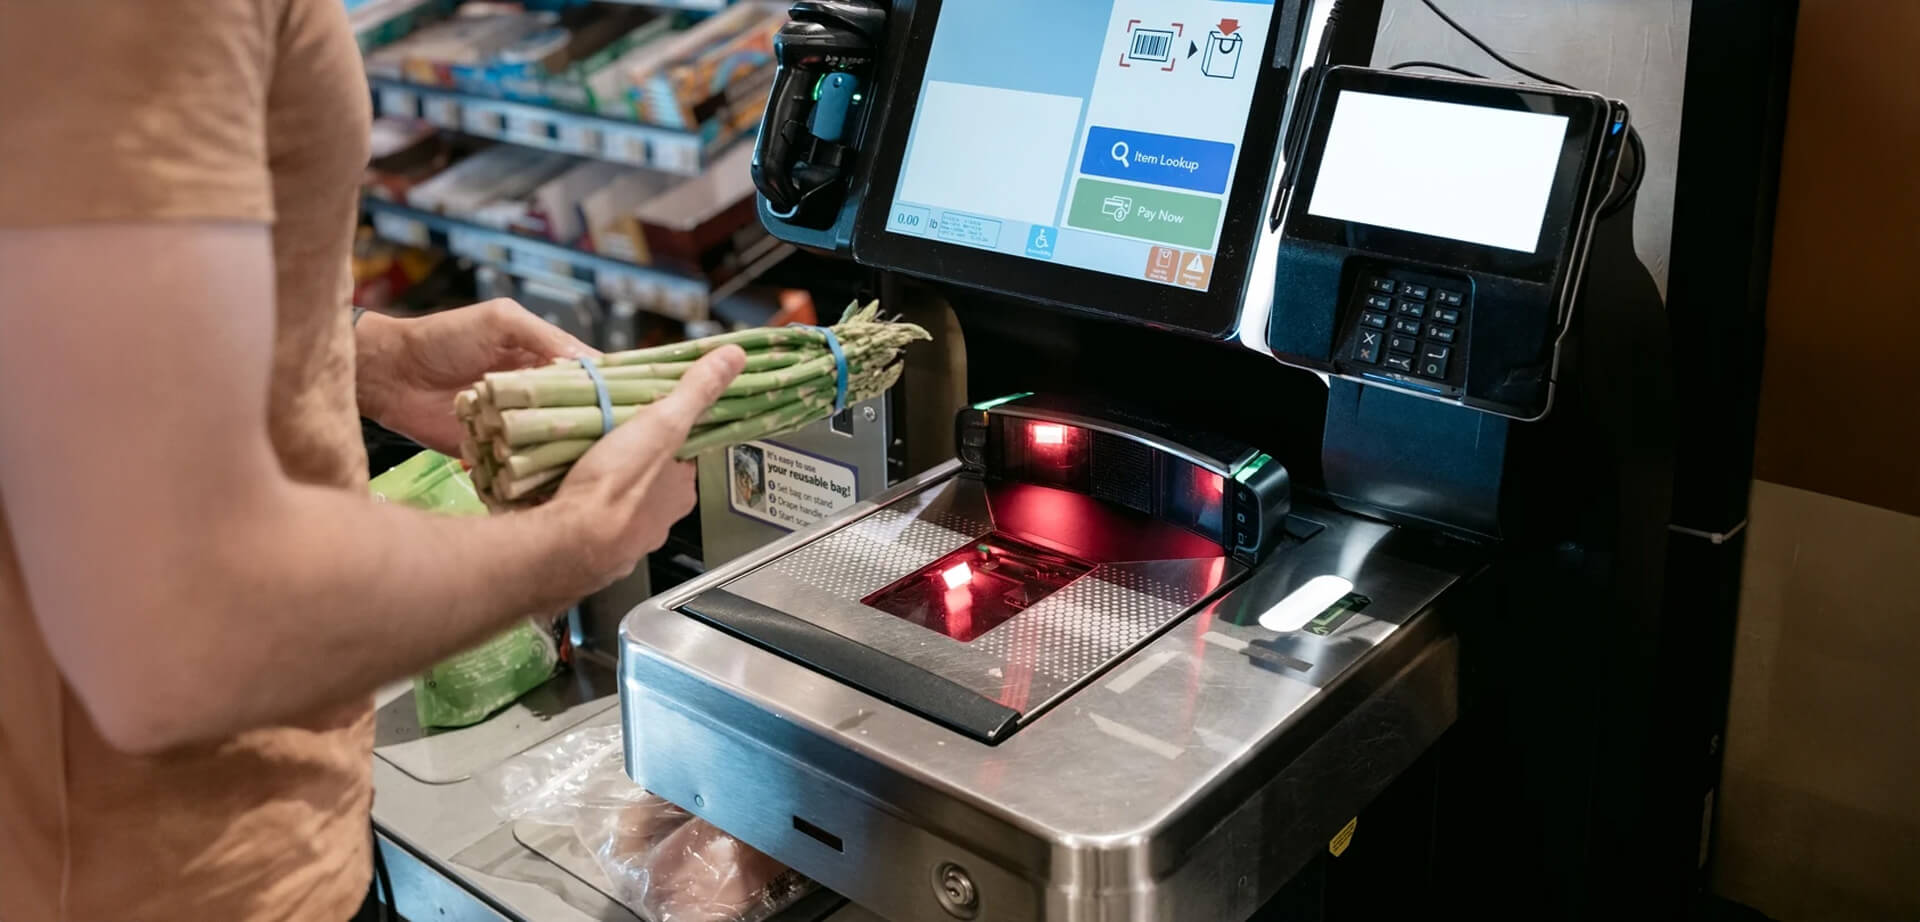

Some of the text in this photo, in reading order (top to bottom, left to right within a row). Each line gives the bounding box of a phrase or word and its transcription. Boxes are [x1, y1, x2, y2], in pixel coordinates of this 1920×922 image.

[1134, 151, 1199, 173] Item Lookup
[897, 212, 919, 227] 0.00
[929, 217, 938, 230] lb
[1137, 206, 1184, 223] Pay Now
[1405, 286, 1412, 294] 2
[1439, 292, 1446, 300] 3
[1401, 303, 1407, 311] 5
[1435, 310, 1441, 318] 6
[1396, 321, 1403, 329] 8
[1431, 328, 1437, 336] 9
[767, 451, 816, 473] It's easy to use
[767, 463, 851, 498] your reusable bag!
[777, 483, 788, 494] Set
[789, 487, 802, 500] bag
[803, 493, 812, 501] on
[813, 497, 833, 509] stand
[777, 496, 798, 511] Drape
[778, 510, 794, 523] Start
